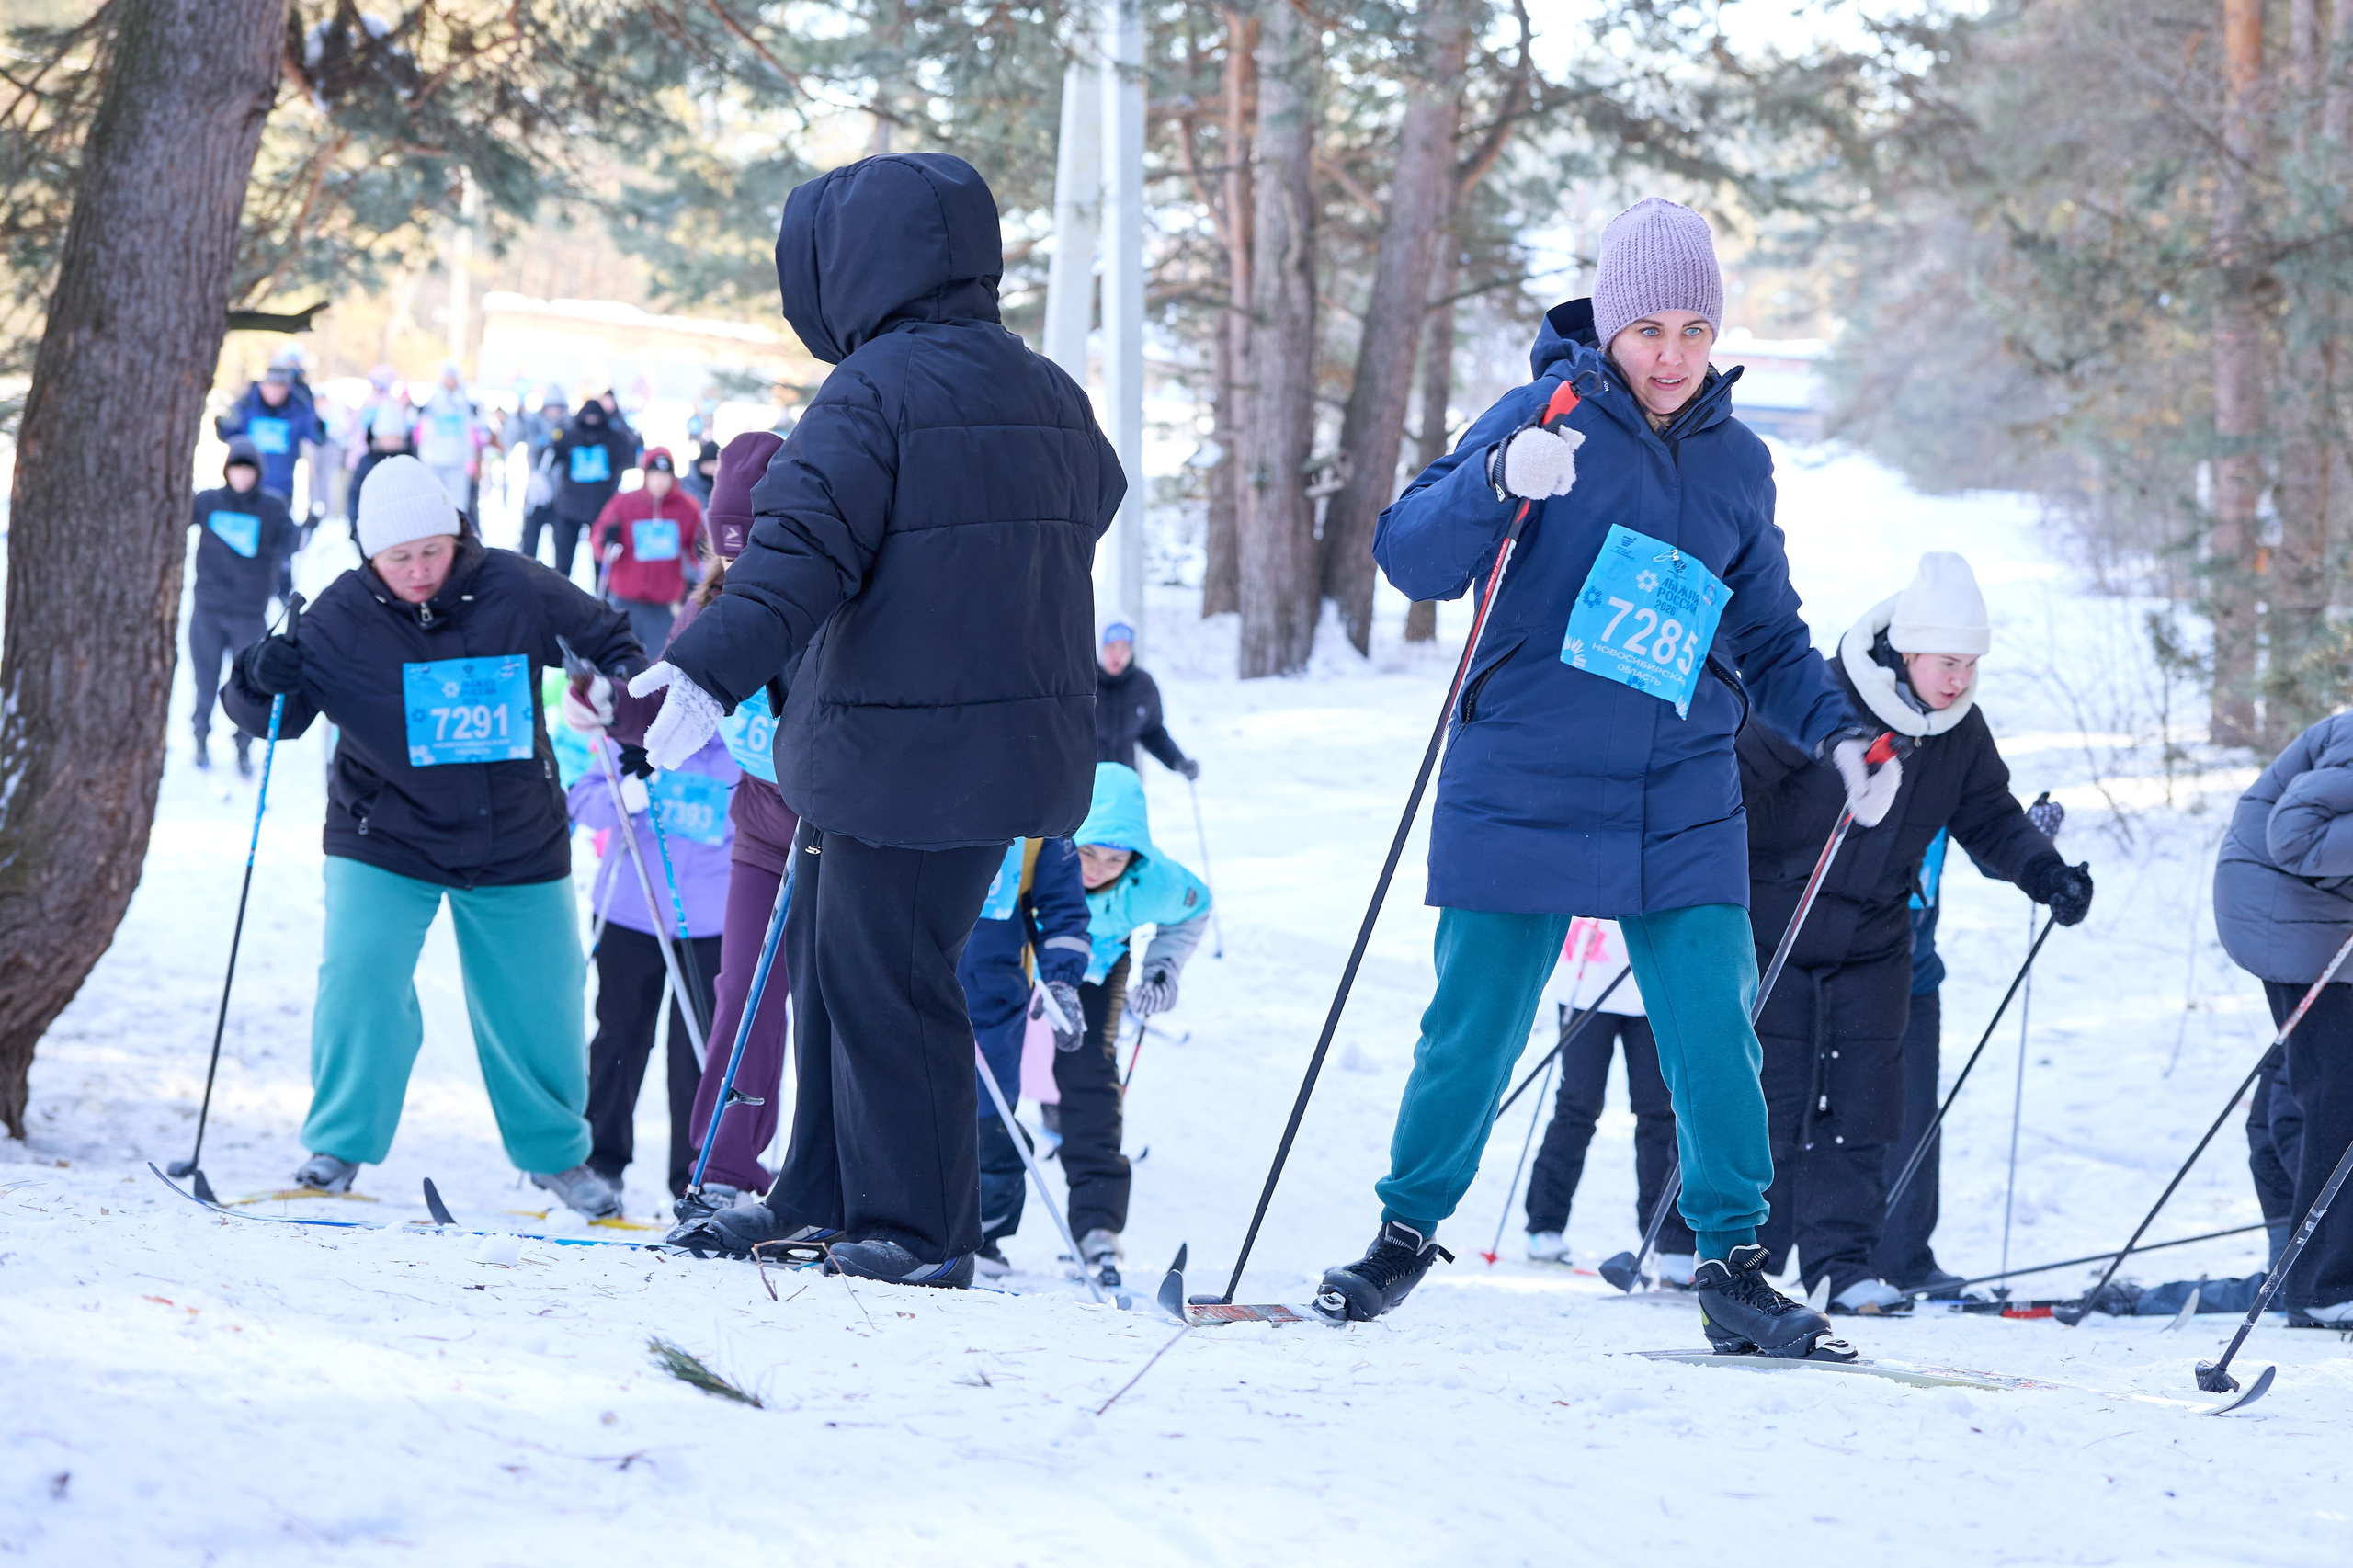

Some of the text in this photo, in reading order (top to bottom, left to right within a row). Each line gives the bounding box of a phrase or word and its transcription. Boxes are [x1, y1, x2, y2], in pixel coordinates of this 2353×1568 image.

[1656, 586, 1698, 616] РОССИИ
[1660, 577, 1700, 606] ЛЫЖНЯ
[1654, 599, 1677, 617] 2026
[1600, 596, 1699, 676] 7285
[1617, 663, 1662, 687] ОБЛАСТЬ
[430, 703, 508, 741] 7291
